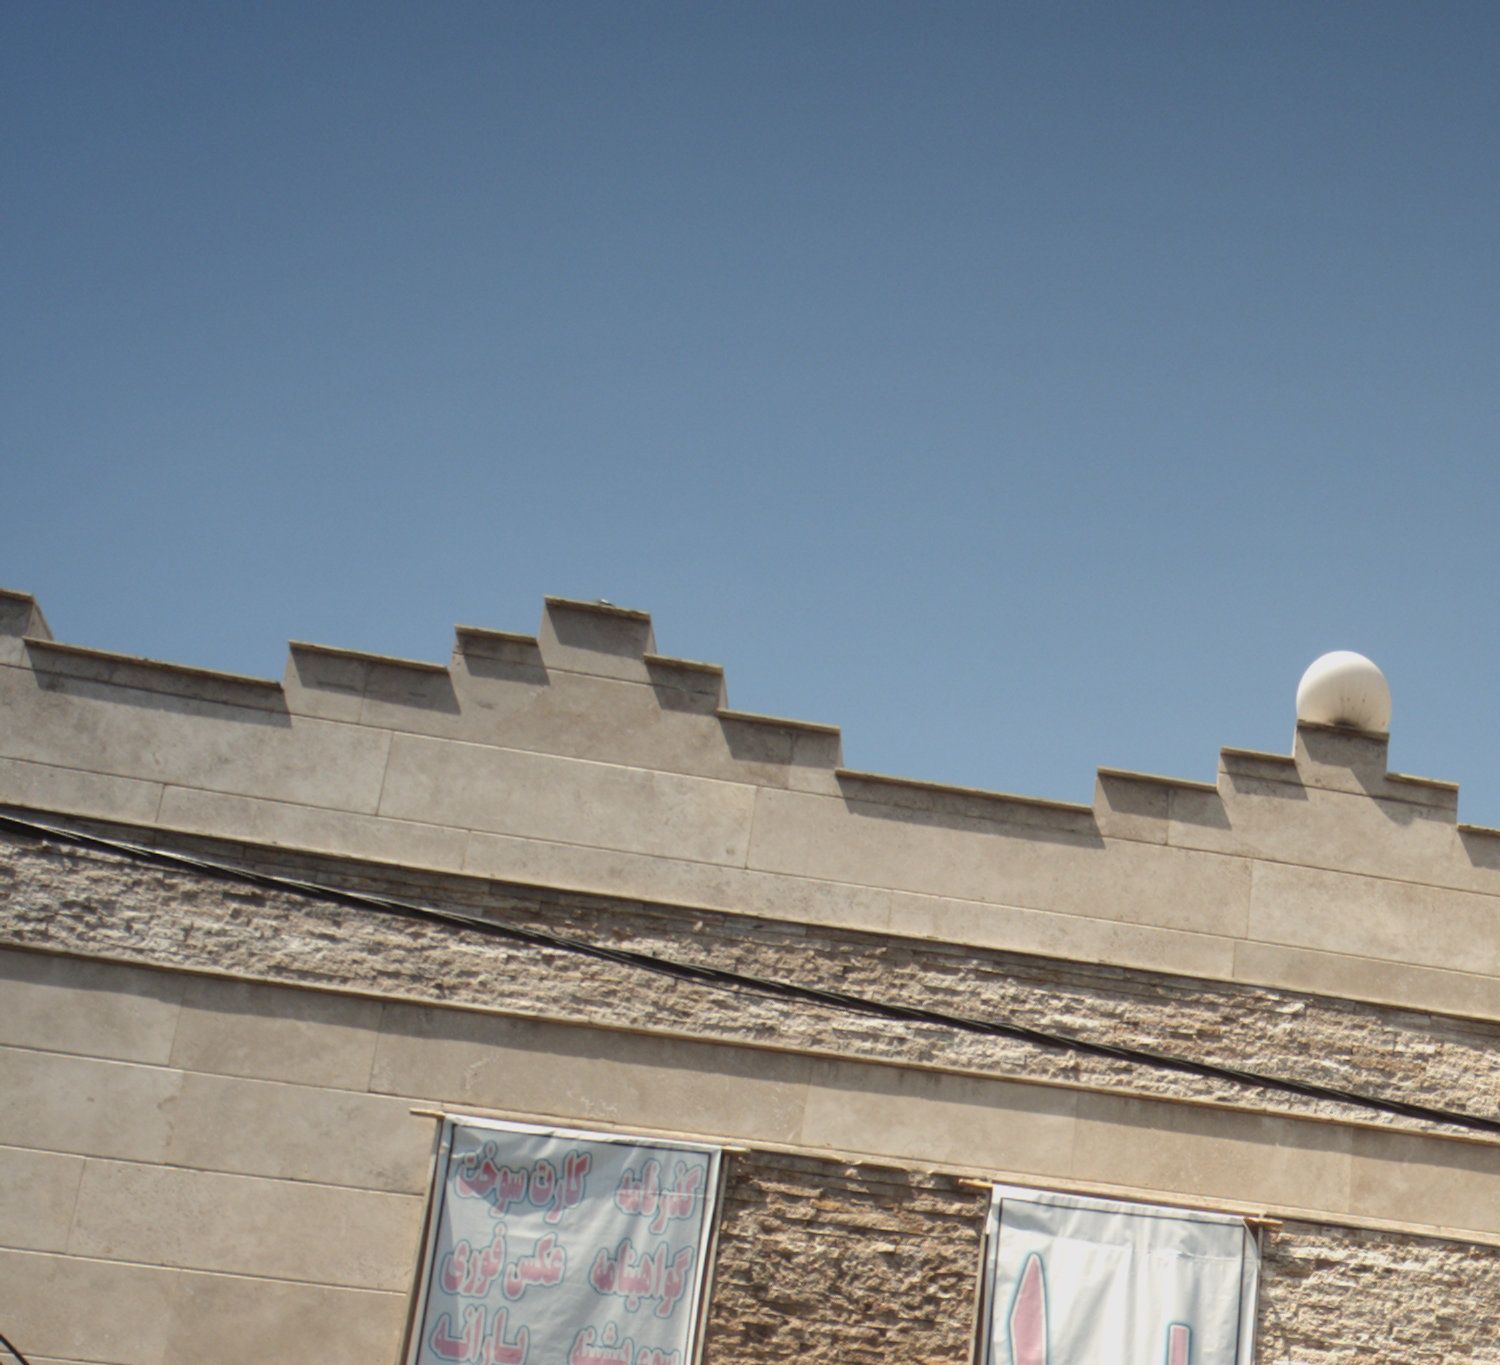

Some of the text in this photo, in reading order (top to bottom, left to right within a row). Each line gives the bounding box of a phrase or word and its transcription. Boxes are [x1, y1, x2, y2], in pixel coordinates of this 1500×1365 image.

[454, 1140, 703, 1234] گذرنامه کارت سوخت
[441, 1221, 506, 1298] فوری
[503, 1232, 567, 1300] عکس
